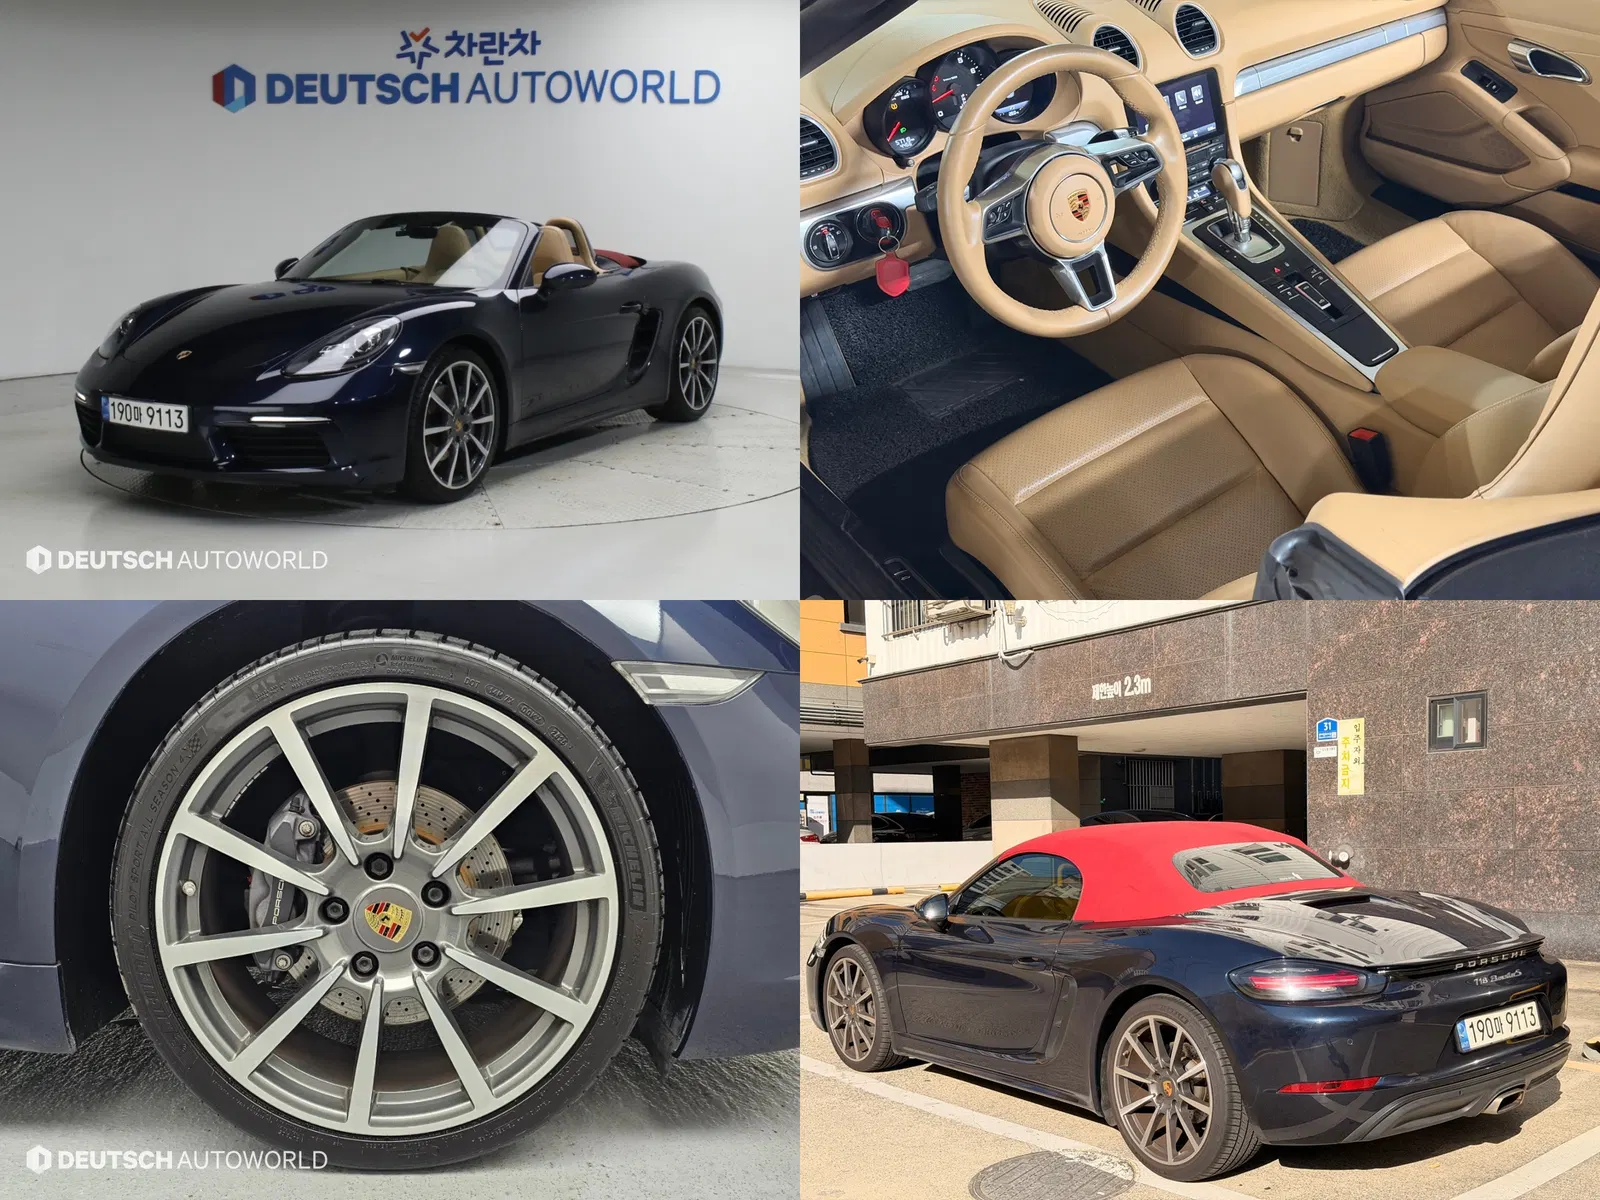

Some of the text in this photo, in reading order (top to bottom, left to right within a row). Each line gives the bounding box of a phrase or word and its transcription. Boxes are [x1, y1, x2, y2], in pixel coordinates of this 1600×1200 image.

[444, 28, 542, 66] 차란차
[266, 68, 722, 105] DEUTSCH AUTOWORLD
[110, 401, 184, 429] 190마 9113
[1323, 721, 1332, 731] 31
[150, 765, 180, 813] SEASON
[139, 815, 154, 838] ALL
[130, 842, 145, 884] SPORT
[609, 802, 646, 911] MICHELIN
[128, 885, 138, 922] PILOT
[272, 879, 285, 926] PORSC
[1453, 949, 1528, 971] PORSCHE
[1473, 976, 1489, 986] 718
[1468, 1006, 1537, 1043] 190마 9113
